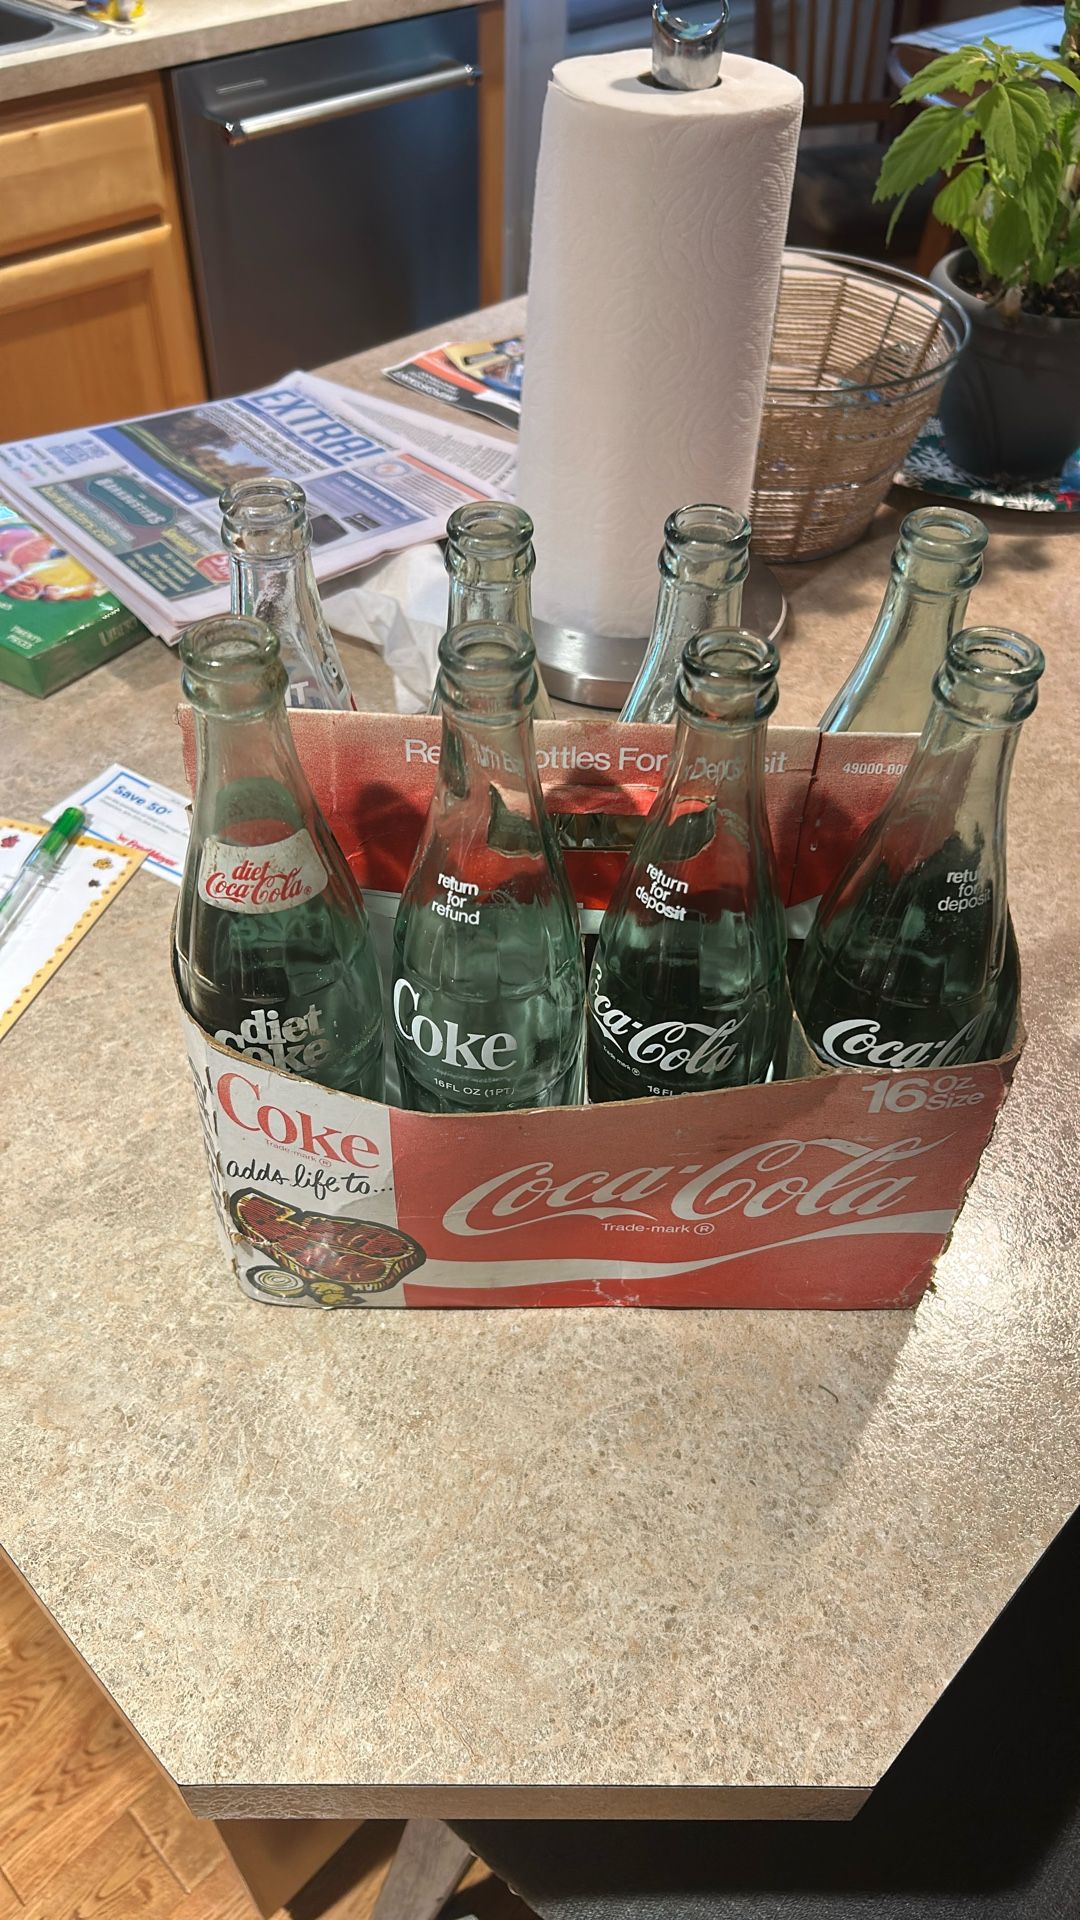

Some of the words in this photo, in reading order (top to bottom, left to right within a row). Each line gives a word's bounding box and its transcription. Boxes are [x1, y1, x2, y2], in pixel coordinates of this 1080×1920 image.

[255, 389, 387, 462] EXTRA!
[618, 748, 667, 772] For
[113, 785, 145, 805] Save
[232, 860, 270, 881] diet
[646, 863, 689, 894] return
[946, 869, 977, 883] retu
[205, 866, 304, 905] Coca-Cola
[438, 873, 479, 896] return
[650, 881, 671, 901] for
[959, 883, 981, 897] for
[447, 890, 467, 908] for
[636, 886, 687, 921] deposit
[431, 901, 480, 925] refund
[240, 1004, 325, 1044] diet
[394, 979, 518, 1071] Coke
[593, 962, 750, 1074] ca-Cola
[822, 1013, 988, 1068] Coca-C
[463, 1087, 481, 1096] OZ
[484, 1088, 515, 1098] (1PT)
[862, 1078, 932, 1114] 16
[933, 1074, 976, 1094] Oz.
[925, 1091, 985, 1111] Size
[216, 1072, 380, 1169] Coke
[226, 1158, 289, 1185] adds
[290, 1164, 340, 1201] life
[441, 1131, 957, 1237] Coca-Cola
[600, 1222, 690, 1234] Trade-mark
